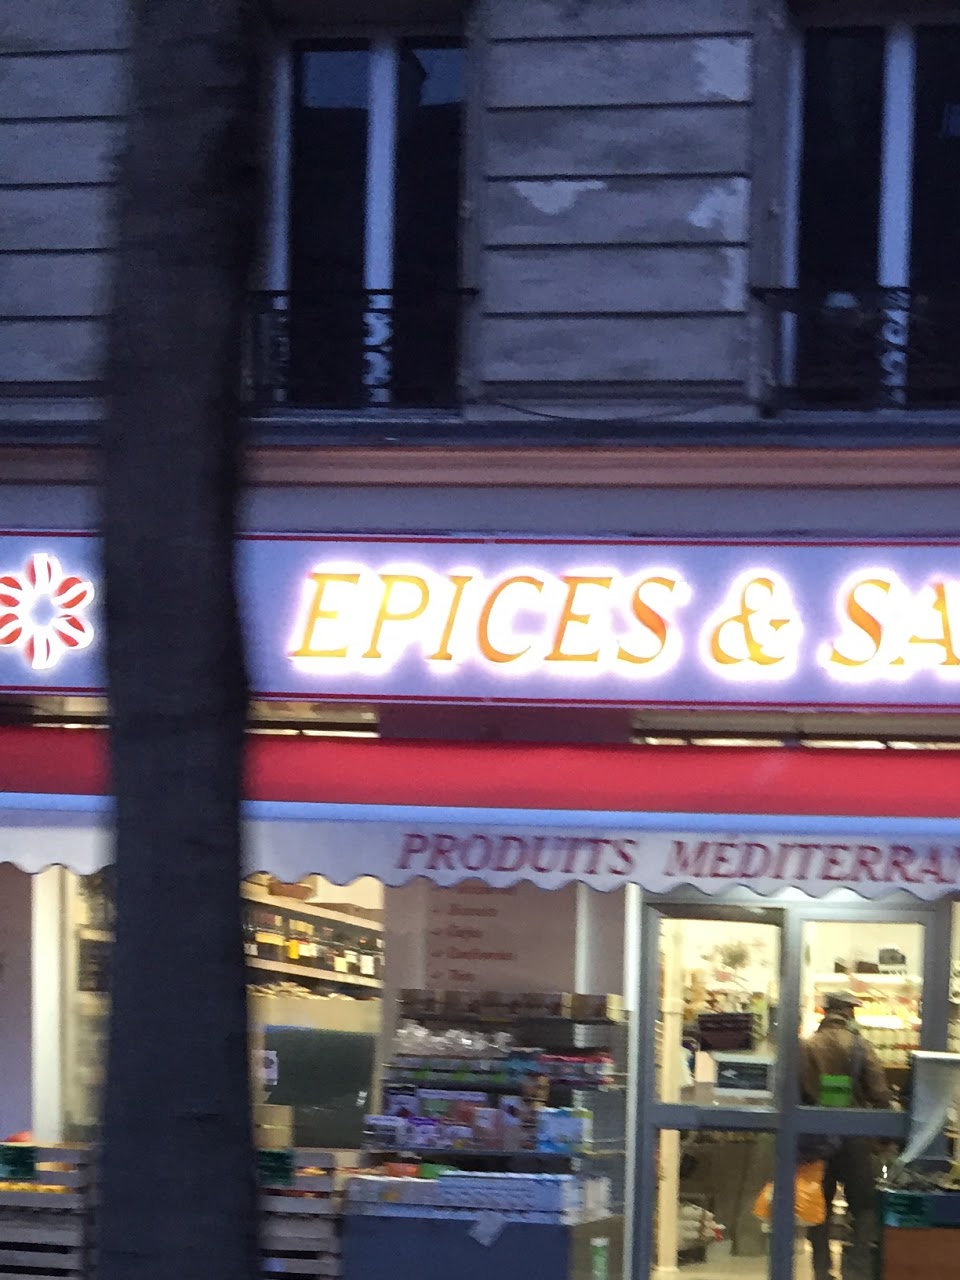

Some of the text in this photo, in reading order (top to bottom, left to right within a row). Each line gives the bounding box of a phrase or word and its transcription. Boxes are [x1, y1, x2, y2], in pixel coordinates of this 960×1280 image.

[287, 572, 678, 666] EPICES
[709, 576, 791, 667] &
[396, 832, 637, 876] PRODUITS
